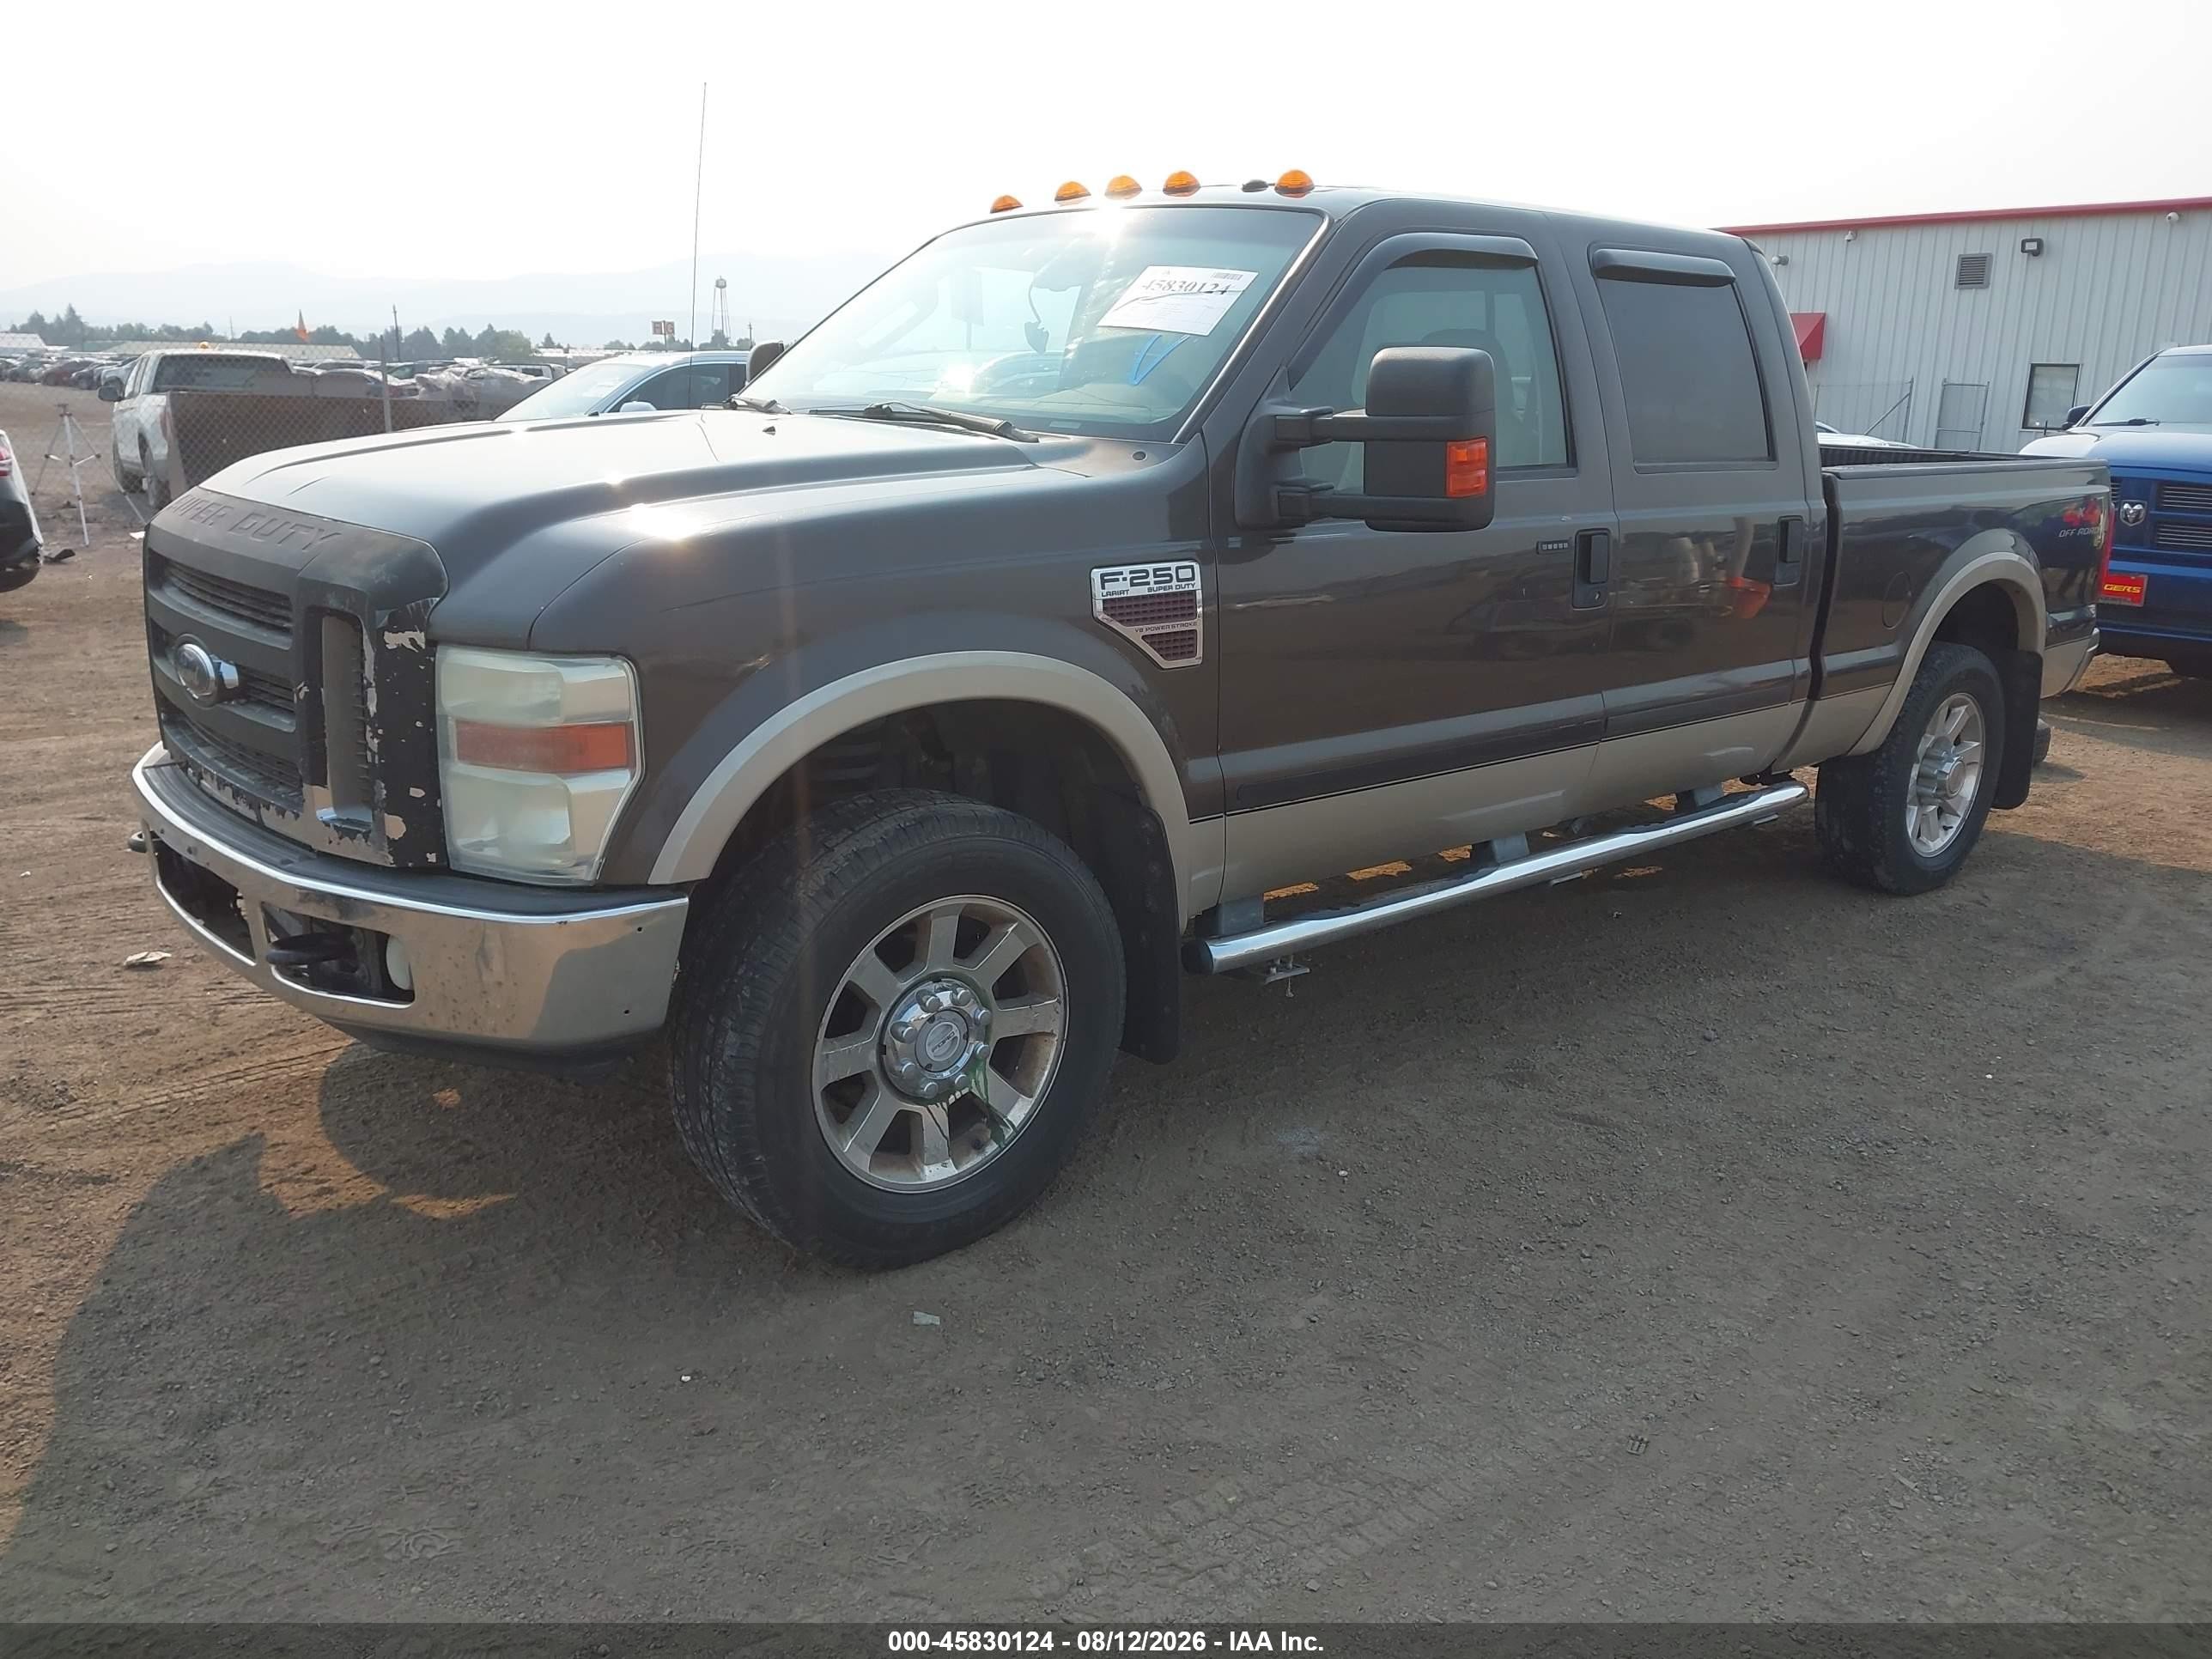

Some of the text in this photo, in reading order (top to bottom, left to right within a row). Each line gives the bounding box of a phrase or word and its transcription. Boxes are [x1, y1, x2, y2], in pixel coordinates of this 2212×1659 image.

[1142, 278, 1235, 295] 45830124
[167, 494, 343, 553] UPER DUTY
[2058, 528, 2076, 538] OFF
[1101, 589, 1130, 598] LARIAT
[1147, 585, 1174, 593] SUPER
[1170, 621, 1198, 629] STROKE
[931, 1030, 956, 1053] FORD
